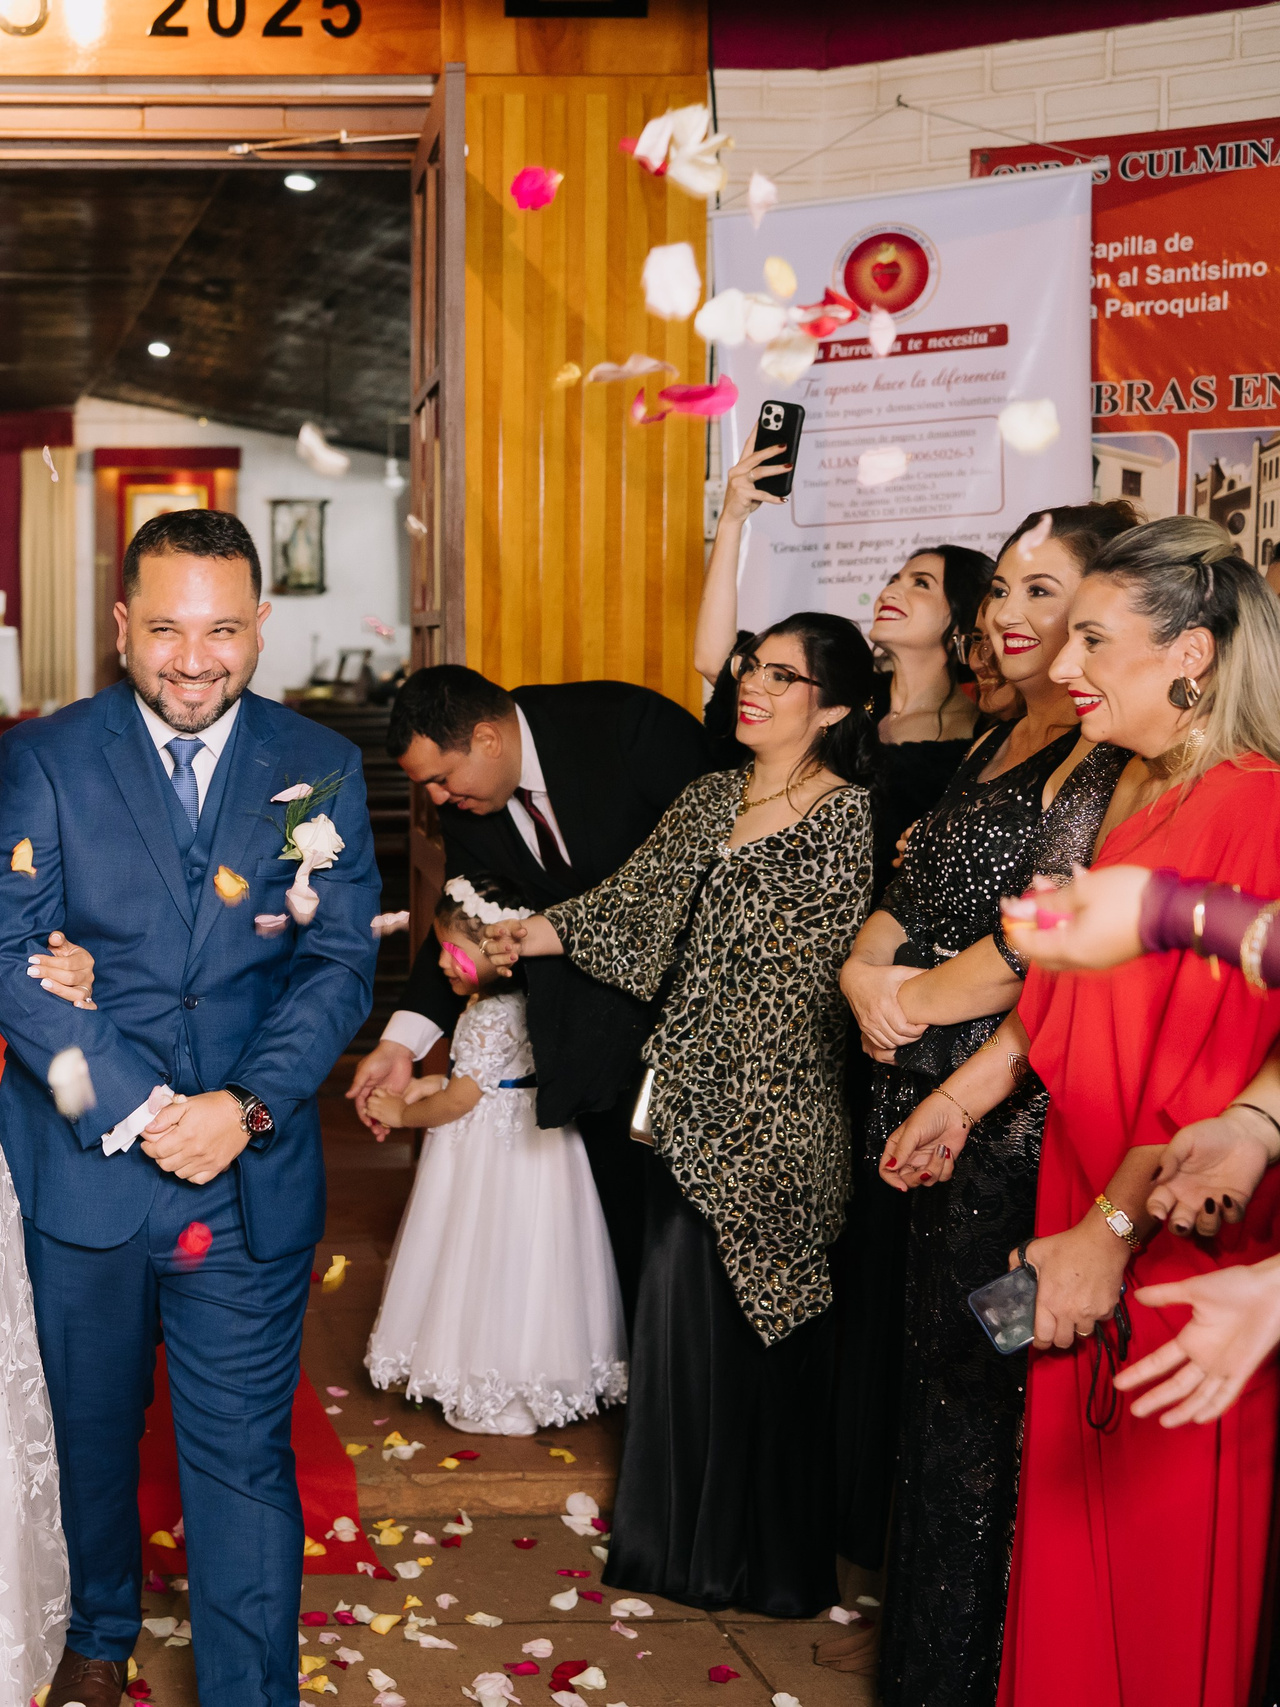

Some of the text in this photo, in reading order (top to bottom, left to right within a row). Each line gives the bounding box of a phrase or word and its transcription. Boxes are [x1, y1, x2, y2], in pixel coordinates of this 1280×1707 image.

[147, 0, 362, 38] 2025
[1118, 137, 1280, 182] CULMIN
[1090, 232, 1194, 262] apilla de
[1117, 266, 1139, 288] al
[1145, 259, 1268, 286] Santísimo
[1105, 290, 1229, 319] Parroquial
[907, 338, 923, 352] te
[799, 367, 1008, 405] Tu aporte hace la diferencia
[1090, 375, 1218, 418] BRAS
[858, 538, 894, 552] pagos
